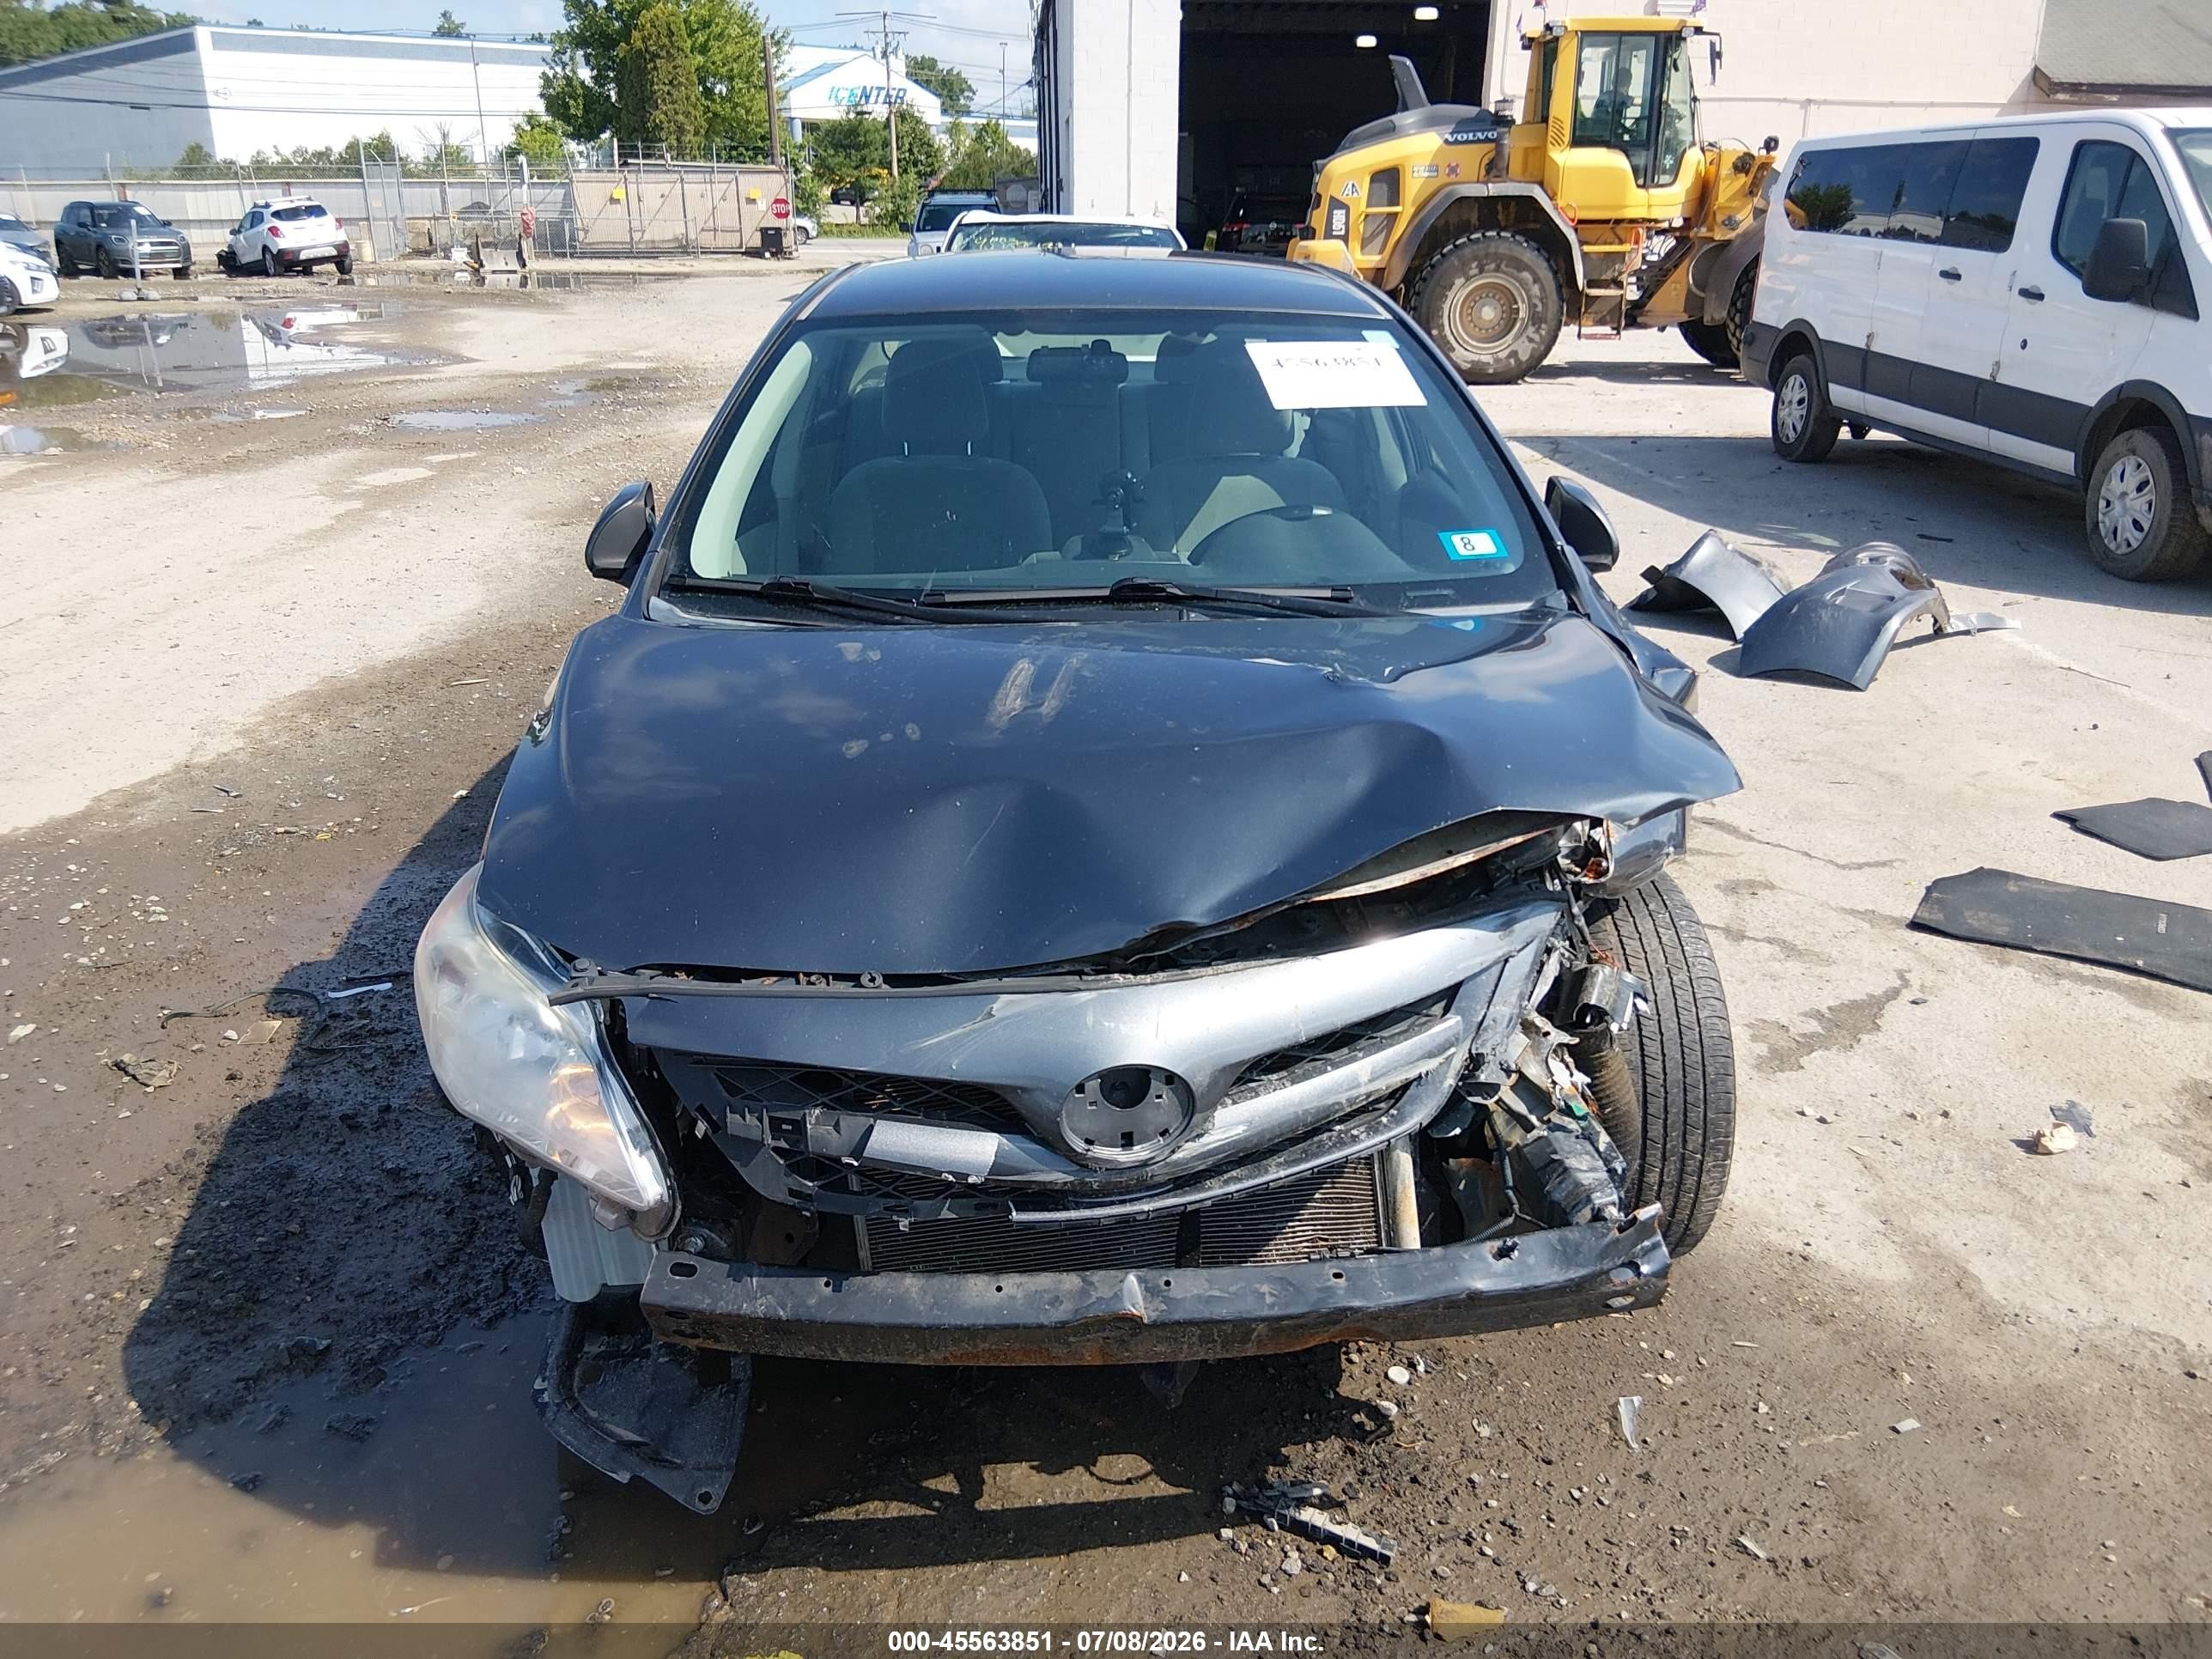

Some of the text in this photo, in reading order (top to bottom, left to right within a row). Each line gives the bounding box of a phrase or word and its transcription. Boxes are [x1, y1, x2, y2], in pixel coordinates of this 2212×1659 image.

[1443, 131, 1498, 142] VOLVO
[1332, 209, 1346, 235] L90H
[1461, 536, 1475, 551] 8
